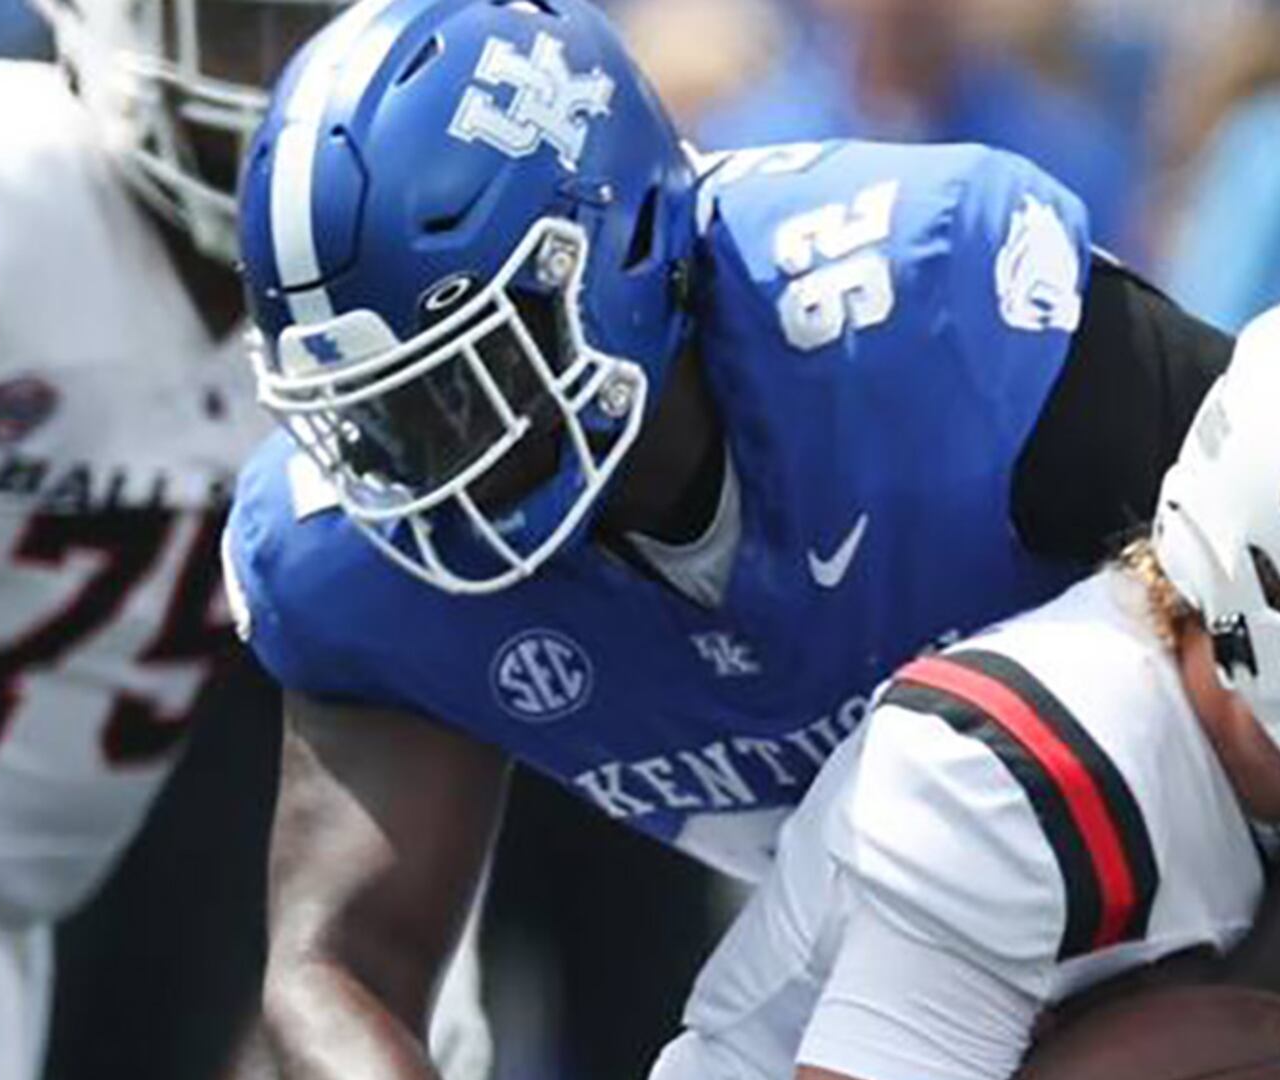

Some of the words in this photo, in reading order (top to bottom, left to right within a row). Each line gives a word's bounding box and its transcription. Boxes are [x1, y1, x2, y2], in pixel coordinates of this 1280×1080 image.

[774, 178, 899, 353] 92
[499, 637, 586, 714] SEC
[572, 694, 869, 819] KENTUC
